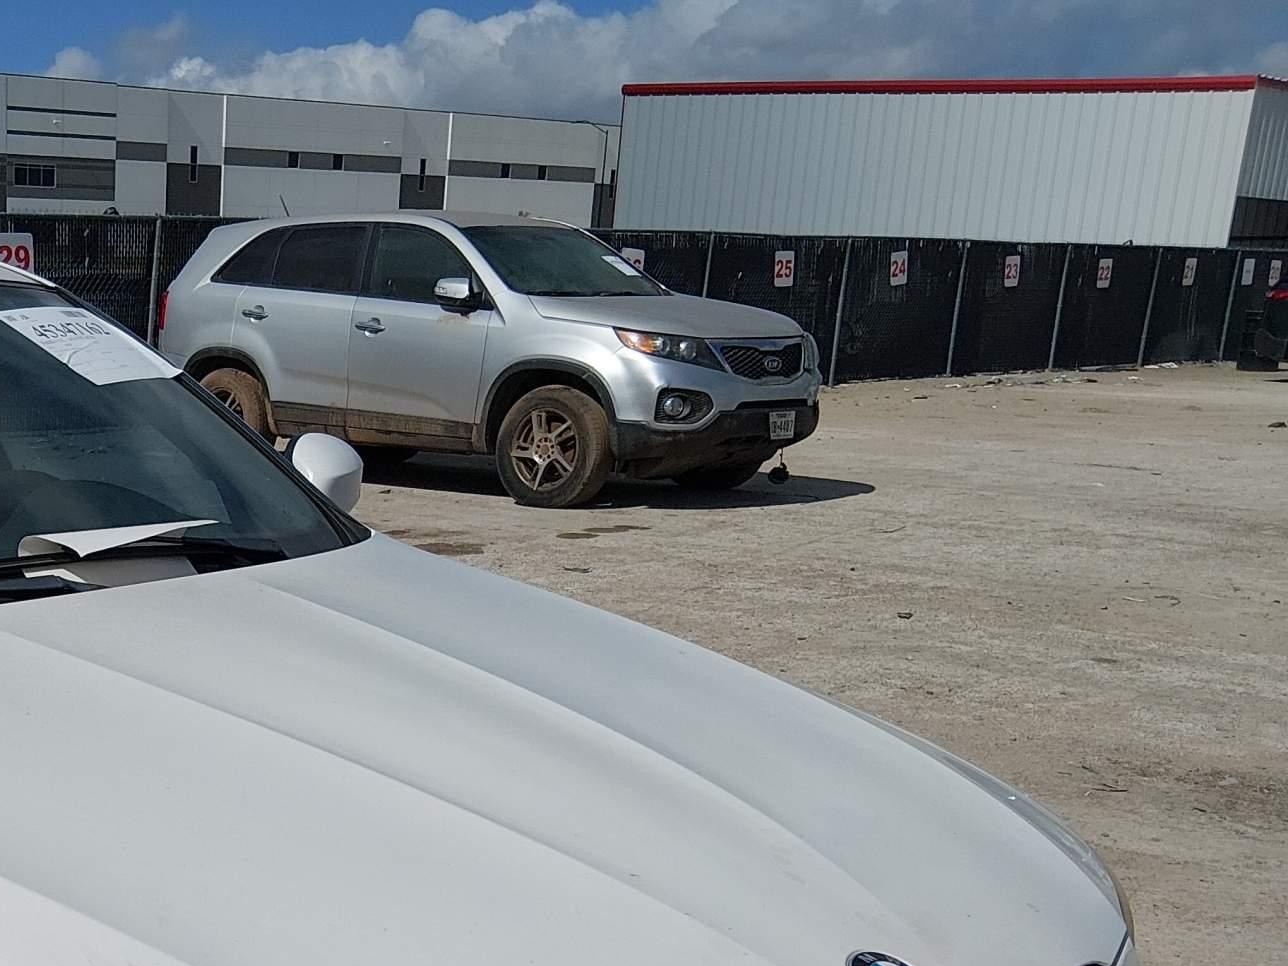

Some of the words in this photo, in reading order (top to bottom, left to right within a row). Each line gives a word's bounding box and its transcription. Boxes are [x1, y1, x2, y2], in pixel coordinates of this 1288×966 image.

[776, 260, 792, 278] 25
[891, 260, 906, 277] 24
[1004, 264, 1019, 279] 23
[1097, 265, 1110, 281] 22
[31, 322, 111, 340] 45347162
